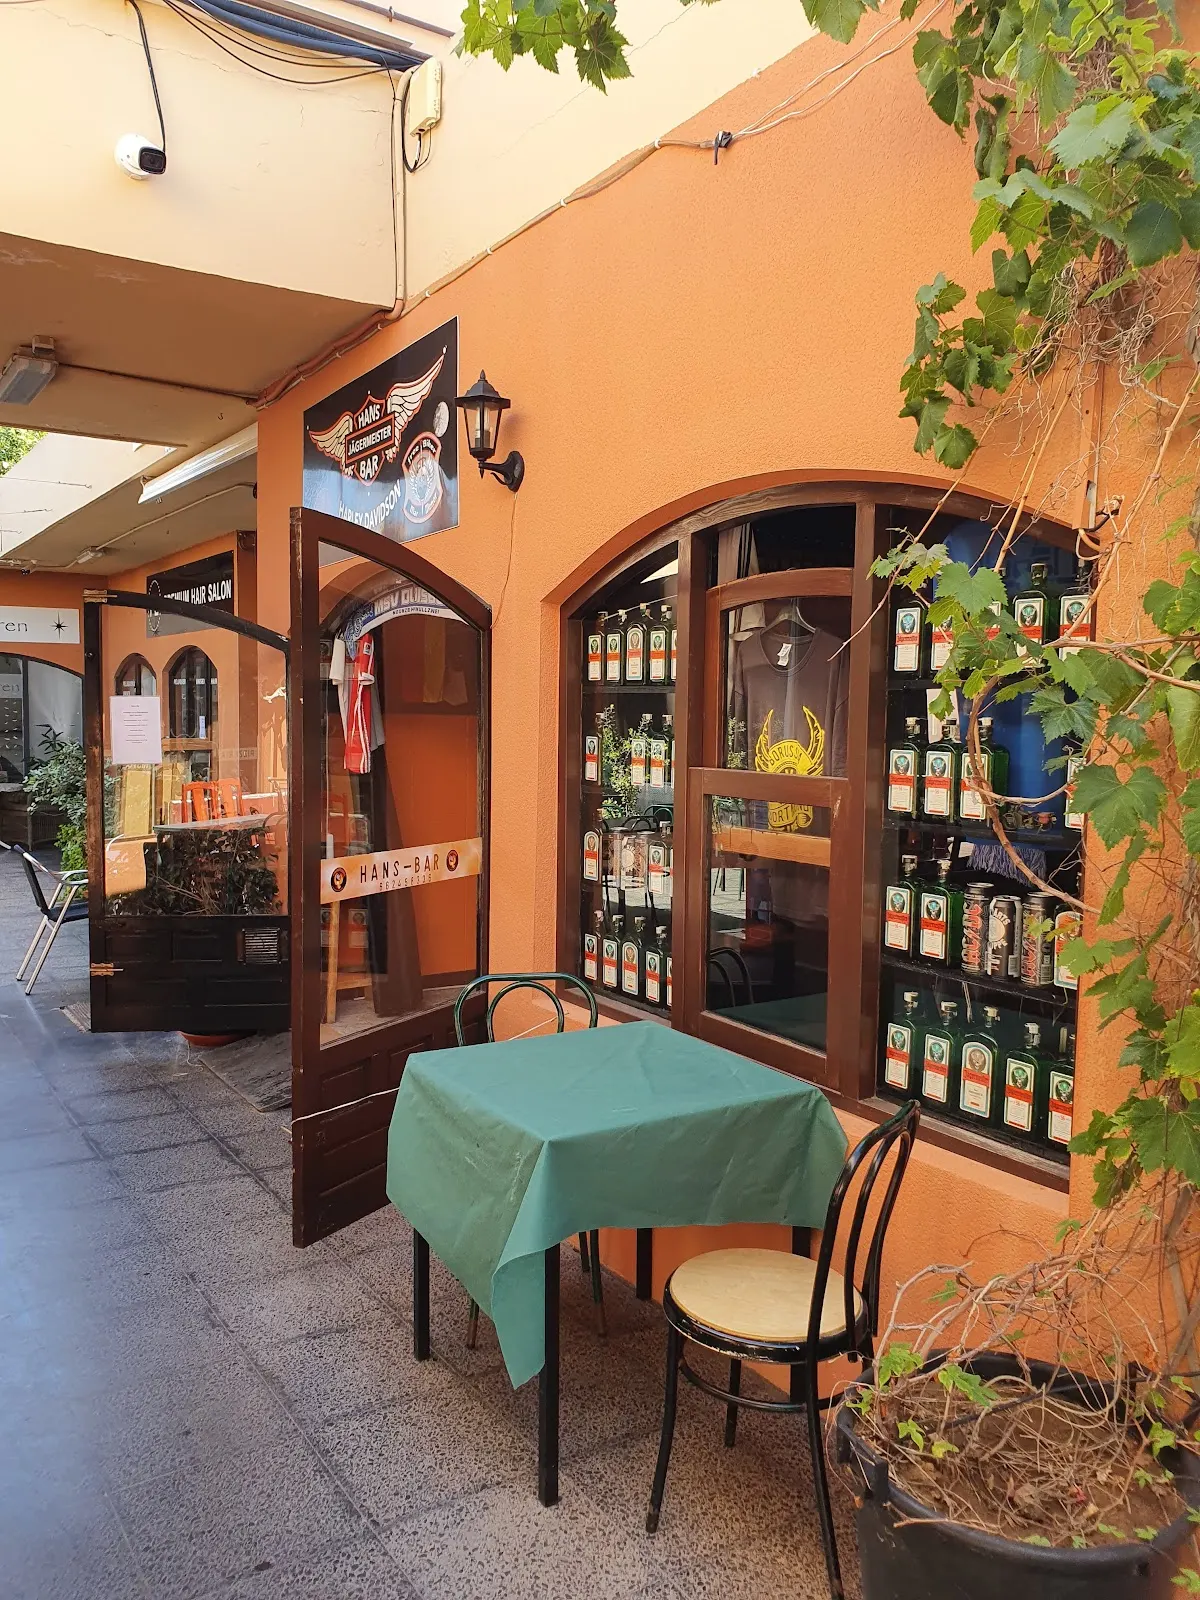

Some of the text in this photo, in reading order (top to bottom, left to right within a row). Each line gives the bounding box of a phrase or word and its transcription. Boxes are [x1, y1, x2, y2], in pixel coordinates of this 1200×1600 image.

[358, 404, 380, 429] HANS
[348, 425, 391, 456] JÄGERMEISTER
[360, 455, 378, 480] BAR
[365, 479, 401, 529] DAVIDSON
[191, 585, 206, 605] HAIR
[208, 579, 232, 603] SALON
[0, 621, 28, 633] en
